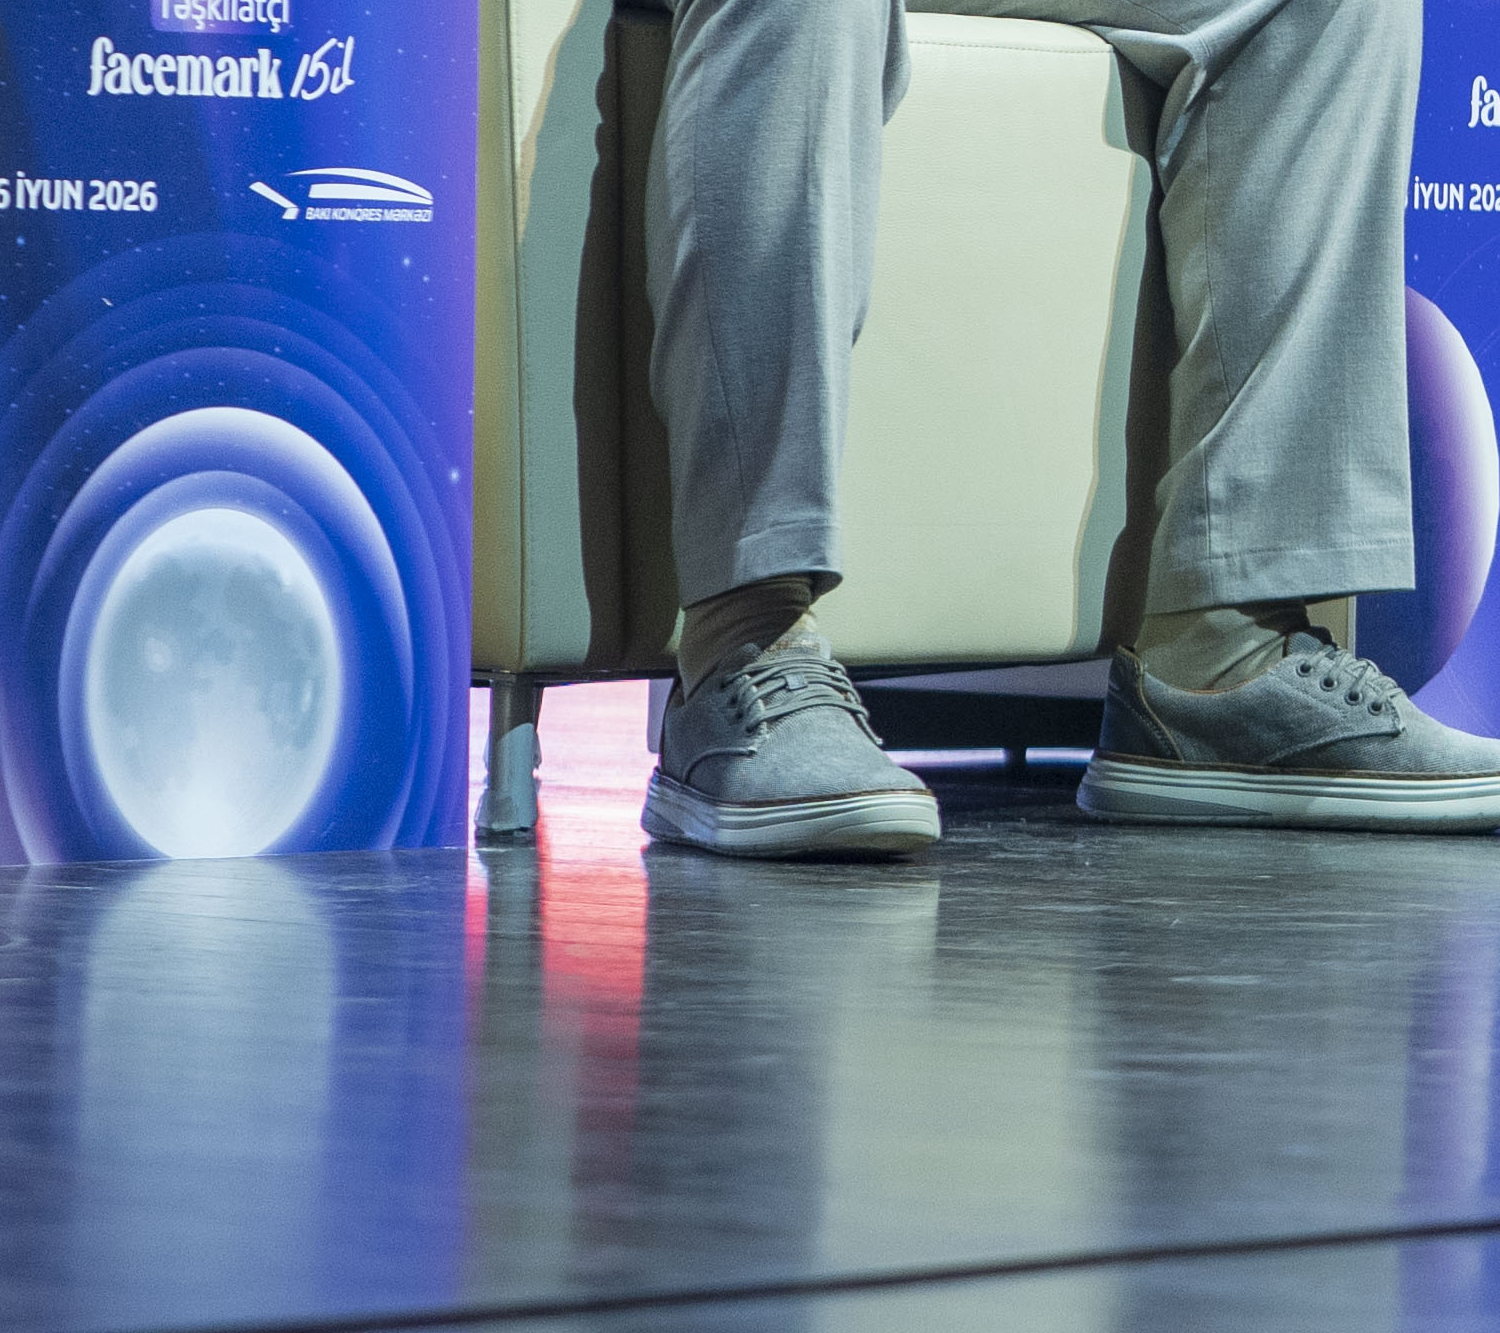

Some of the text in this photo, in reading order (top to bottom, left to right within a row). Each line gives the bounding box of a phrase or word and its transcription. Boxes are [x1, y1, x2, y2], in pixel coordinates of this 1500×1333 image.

[87, 36, 284, 99] facemark
[16, 170, 84, 210] İYUN
[88, 179, 158, 212] 2026
[1414, 175, 1464, 211] İYUN
